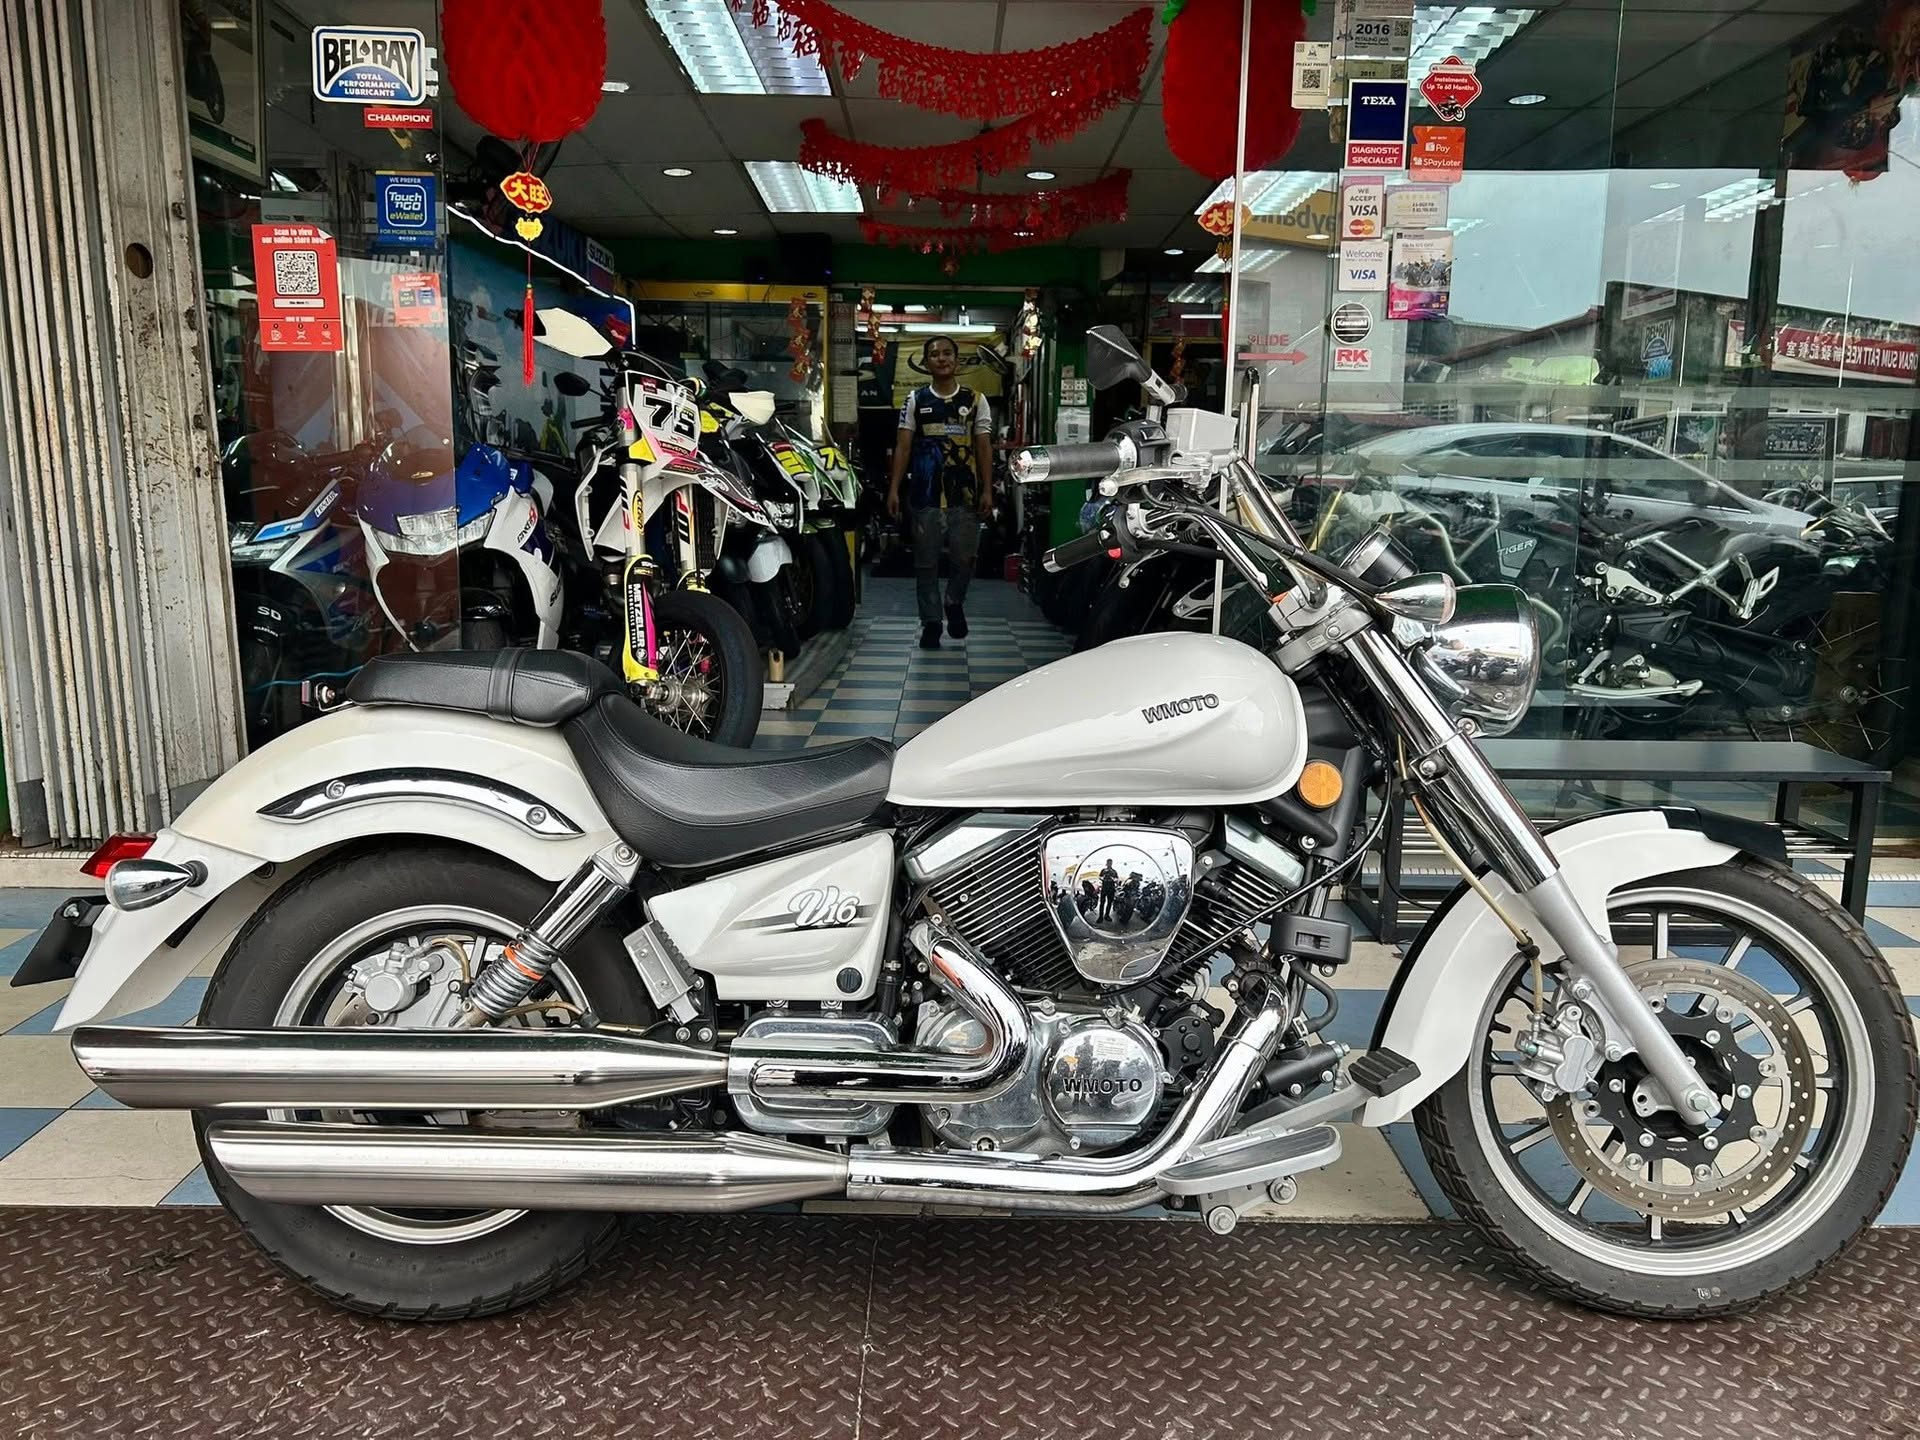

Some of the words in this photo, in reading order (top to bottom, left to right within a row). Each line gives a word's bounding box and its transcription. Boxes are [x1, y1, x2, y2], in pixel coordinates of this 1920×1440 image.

[1354, 24, 1391, 36] 2016
[339, 80, 400, 89] PERFORMANCE
[345, 88, 395, 97] LUBRICANTS
[1361, 96, 1397, 106] TEXA
[367, 113, 431, 123] CHAMPION
[1351, 147, 1399, 155] DIAGNOSTIC
[1436, 144, 1450, 154] Pay
[1351, 156, 1398, 164] SPECIALIST
[389, 192, 422, 202] Touch
[508, 180, 548, 206] 大旺
[1349, 205, 1378, 216] VISA
[390, 212, 423, 220] eWallet
[1346, 250, 1383, 258] Welcome
[1349, 270, 1377, 280] VISA
[1248, 334, 1290, 347] SLIDE
[1337, 349, 1369, 362] RK
[1497, 539, 1535, 555] TIGER
[628, 584, 636, 627] MOTORCYCLE
[257, 606, 282, 622] SD
[633, 583, 646, 648] METZELER
[1141, 693, 1220, 724] WMOTO
[1063, 1078, 1143, 1093] WMOTO
